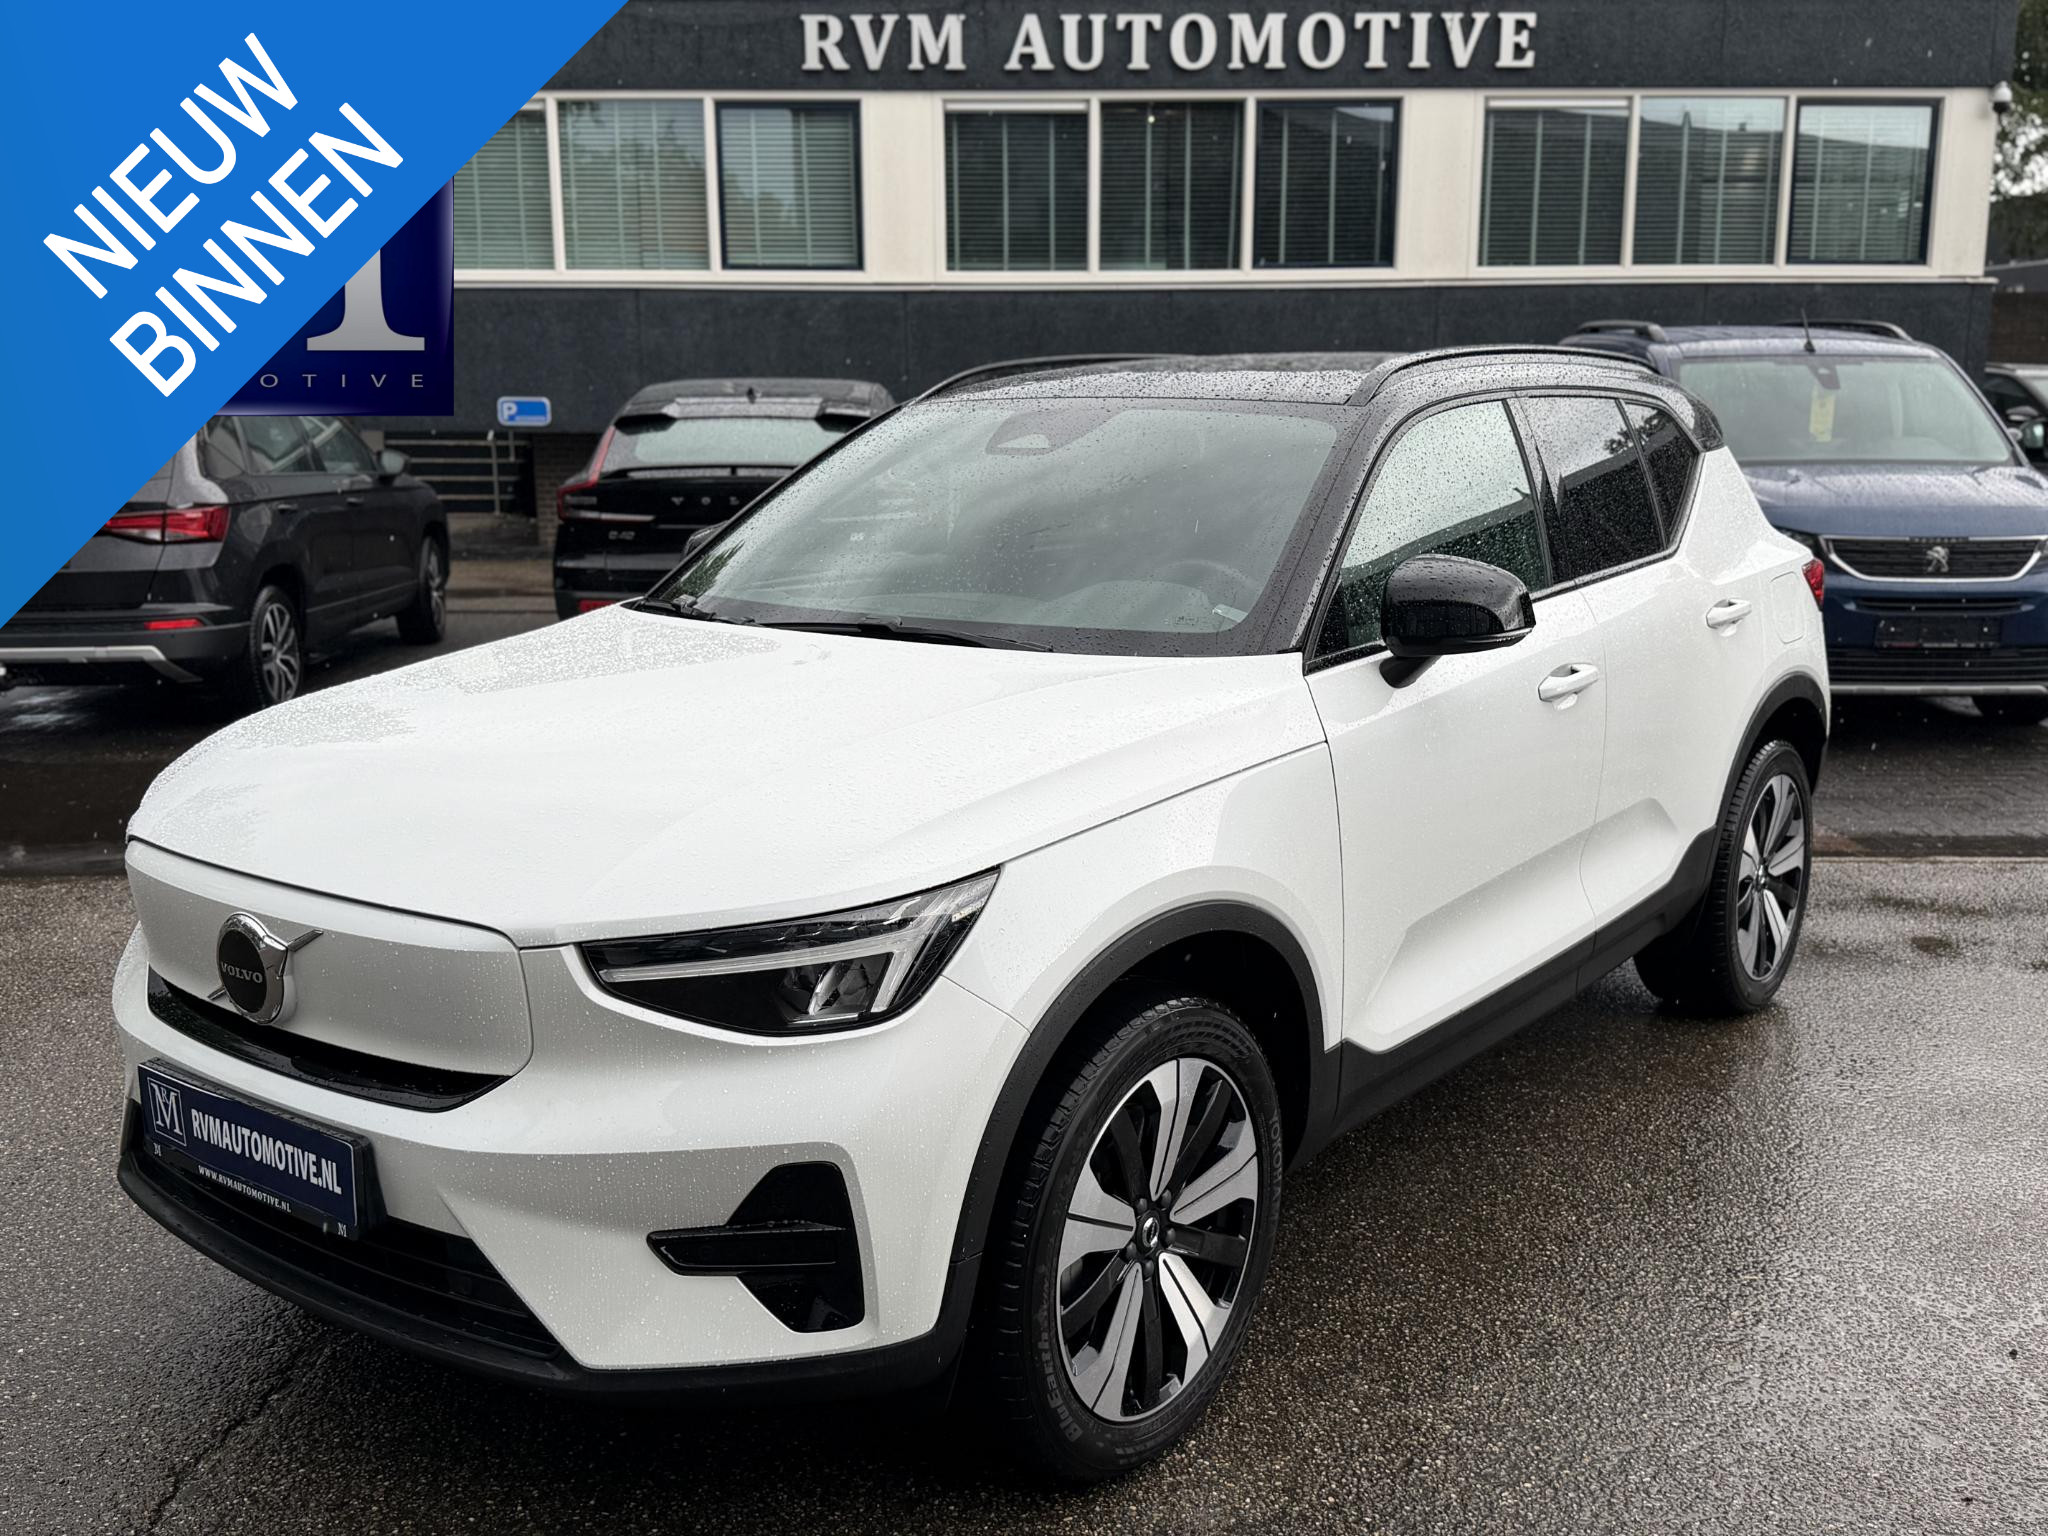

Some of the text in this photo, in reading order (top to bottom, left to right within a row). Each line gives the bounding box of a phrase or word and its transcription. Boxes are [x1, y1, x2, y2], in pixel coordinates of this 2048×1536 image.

[801, 12, 1538, 72] RVM AUTOMOTIVE
[221, 962, 263, 984] VOLVO
[191, 1108, 342, 1195] RVMAUTOMOTIVE.NL
[198, 1164, 292, 1213] WWW.RVMAUTOMOTIVE.NL
